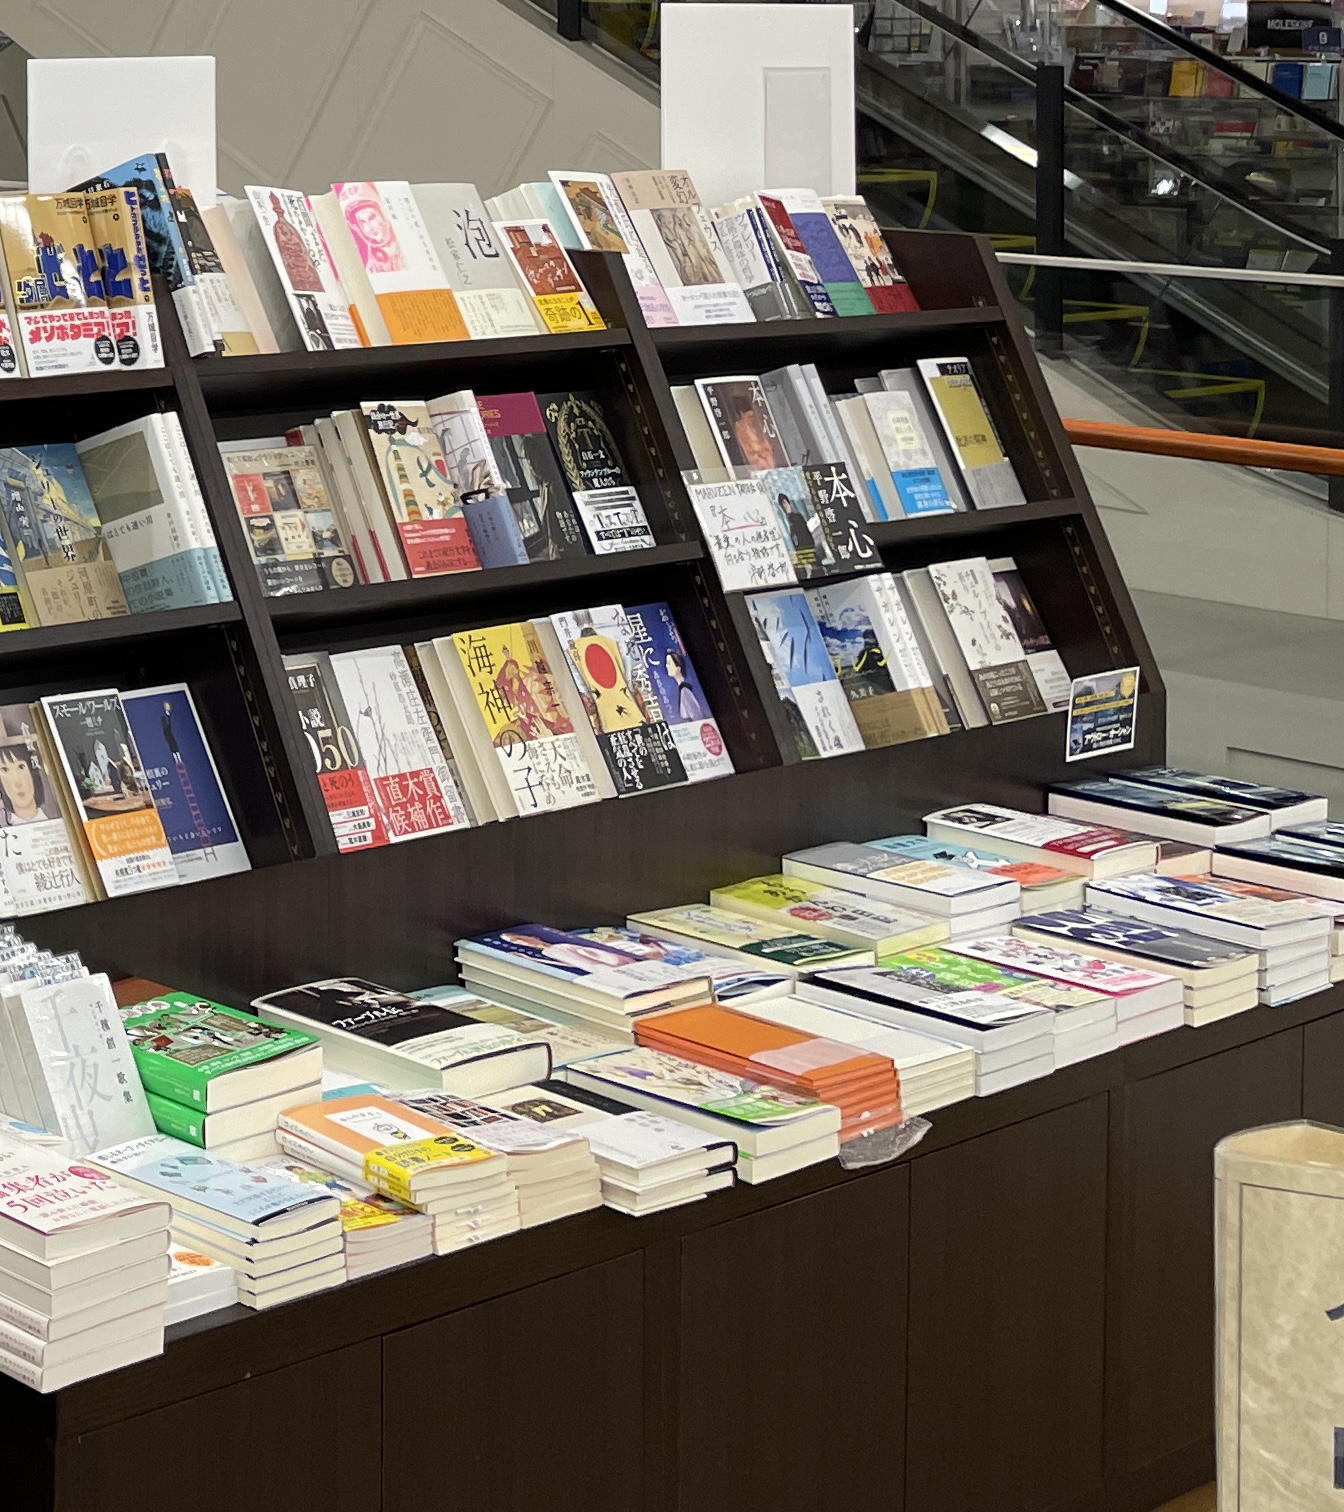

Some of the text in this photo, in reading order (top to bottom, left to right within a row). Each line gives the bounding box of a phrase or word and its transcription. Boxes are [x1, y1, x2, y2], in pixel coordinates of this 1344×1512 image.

[451, 208, 500, 259] 泡
[747, 384, 775, 441] 本心
[823, 466, 875, 560] 本心
[52, 697, 122, 719] スモールワールズ
[459, 634, 545, 809] 海神の子
[385, 769, 442, 805] 直木賞
